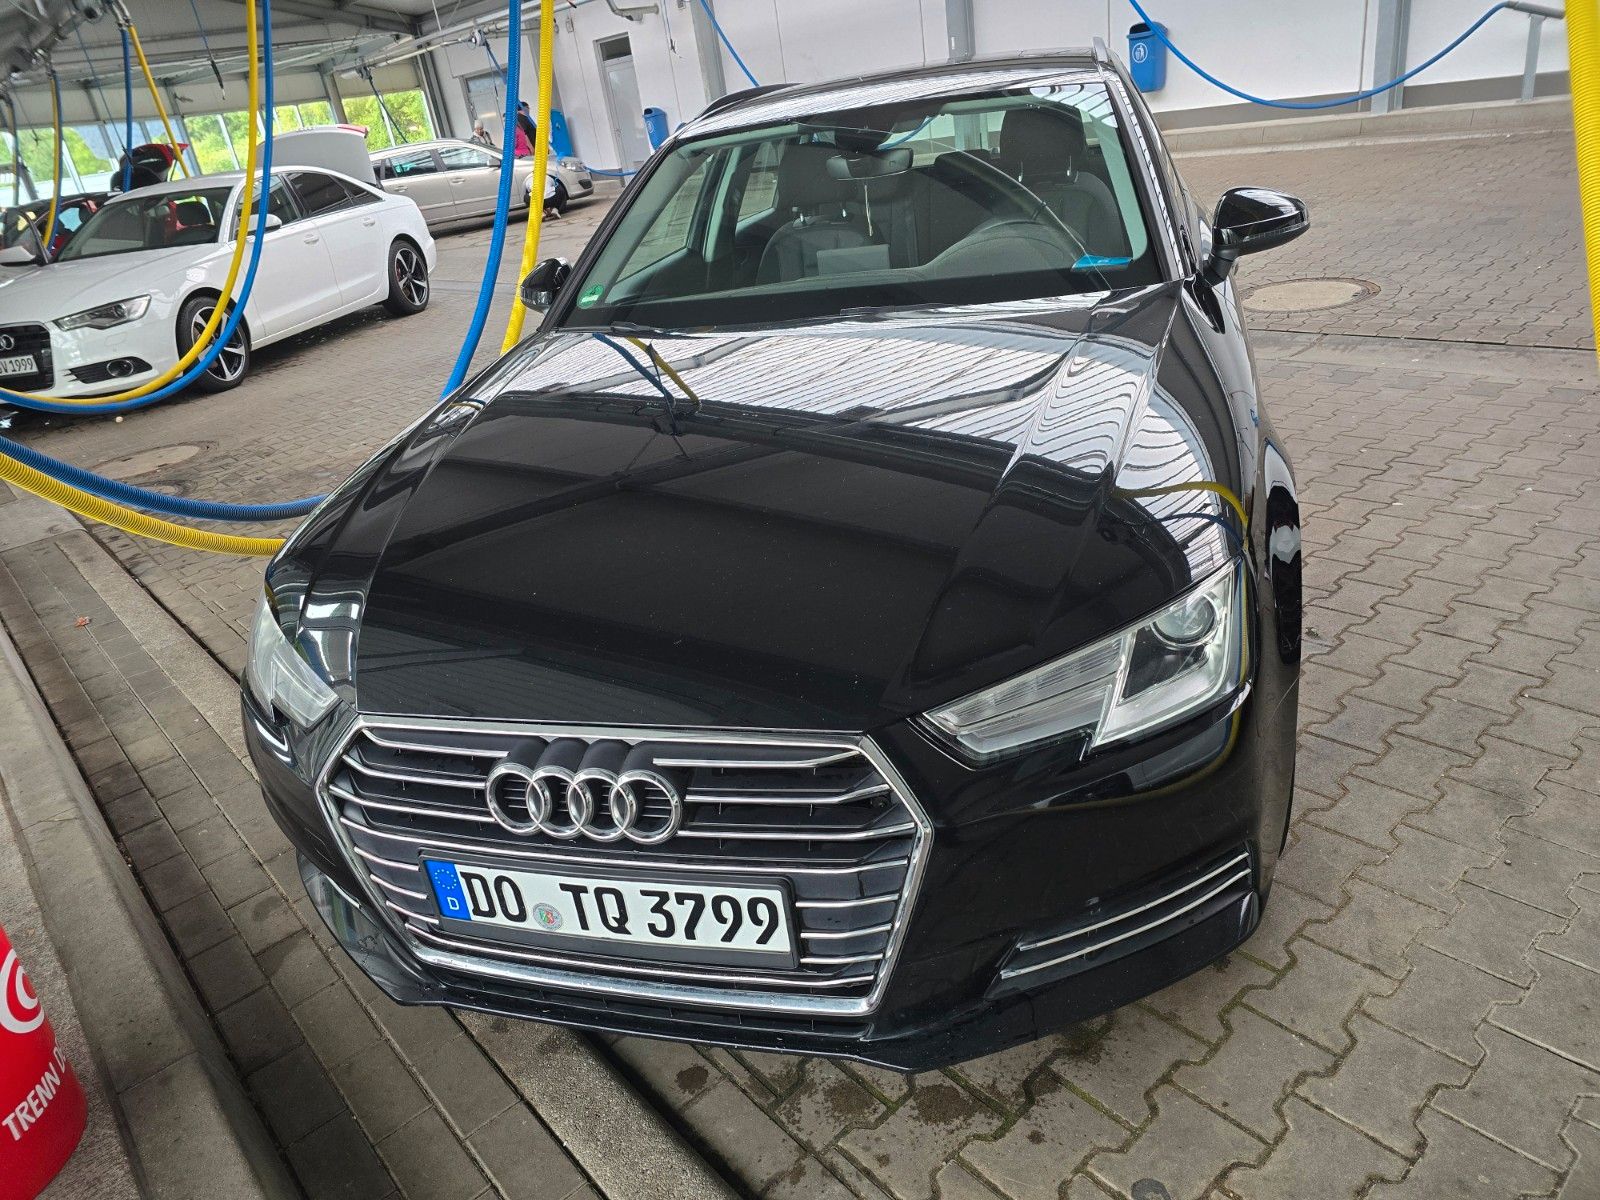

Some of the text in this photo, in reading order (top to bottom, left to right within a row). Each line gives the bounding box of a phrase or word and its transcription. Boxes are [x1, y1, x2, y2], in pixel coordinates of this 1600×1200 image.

[9, 357, 33, 373] 1999
[447, 897, 459, 911] D
[460, 871, 528, 923] DO
[558, 882, 632, 935] TQ
[639, 889, 779, 945] 3799
[1, 1061, 61, 1141] TRENN
